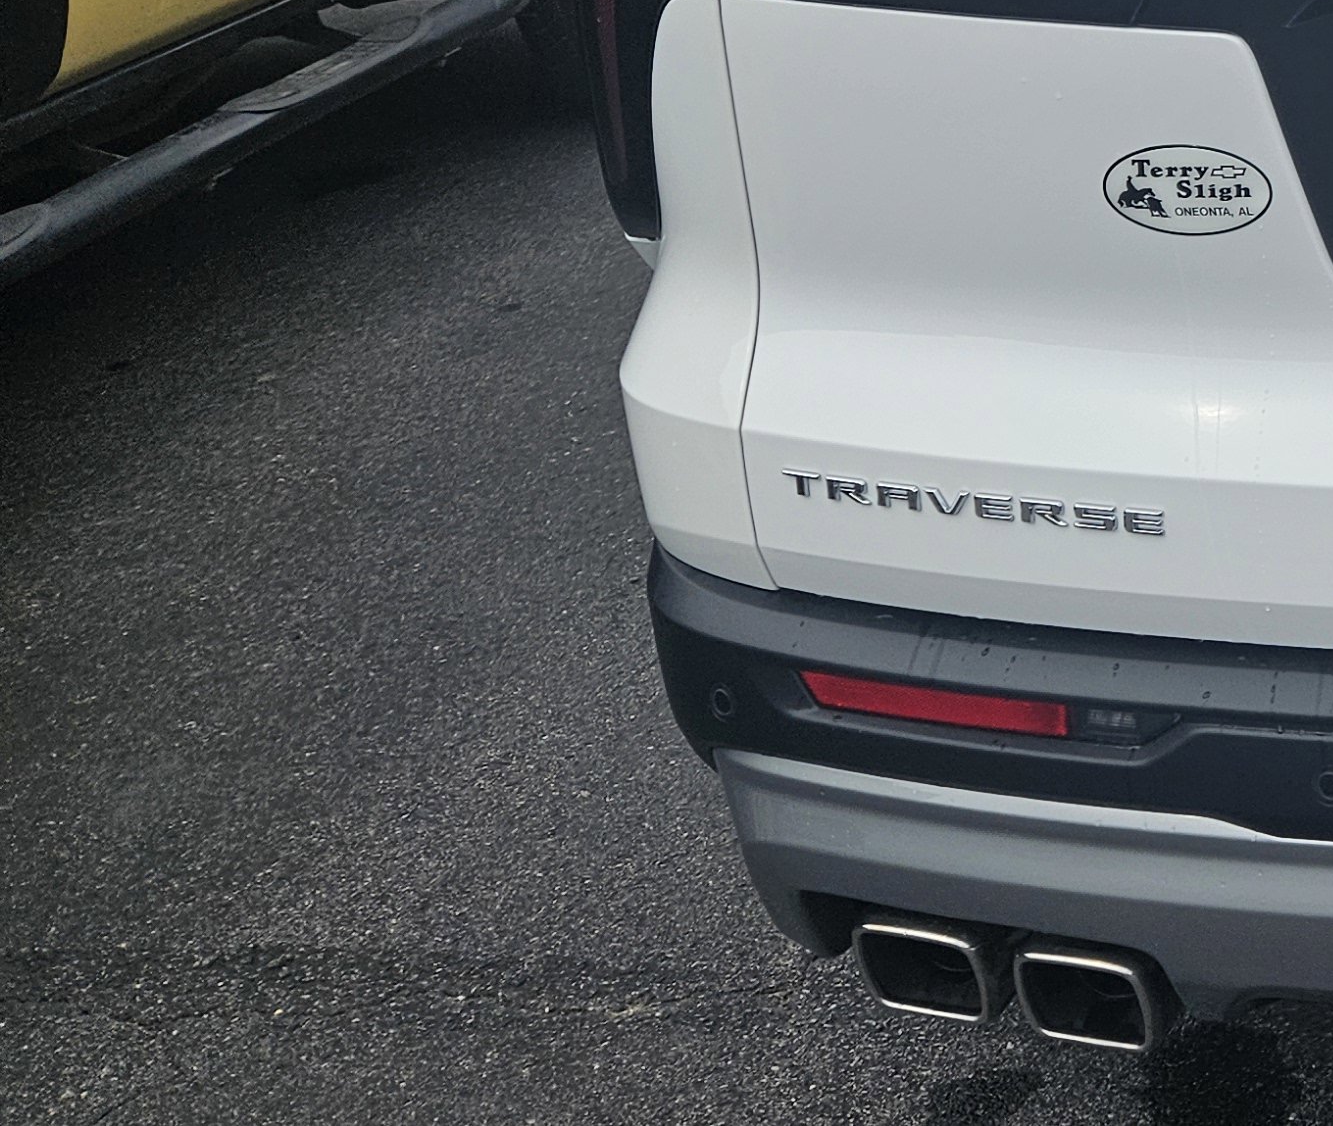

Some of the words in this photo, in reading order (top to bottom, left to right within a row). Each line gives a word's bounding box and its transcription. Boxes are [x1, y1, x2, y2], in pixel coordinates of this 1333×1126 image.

[1131, 159, 1209, 180] Terry
[1176, 180, 1253, 201] Sligh
[1174, 206, 1235, 218] ONEONTA,
[1238, 207, 1255, 217] AL
[781, 467, 1166, 537] TRAVERSE
